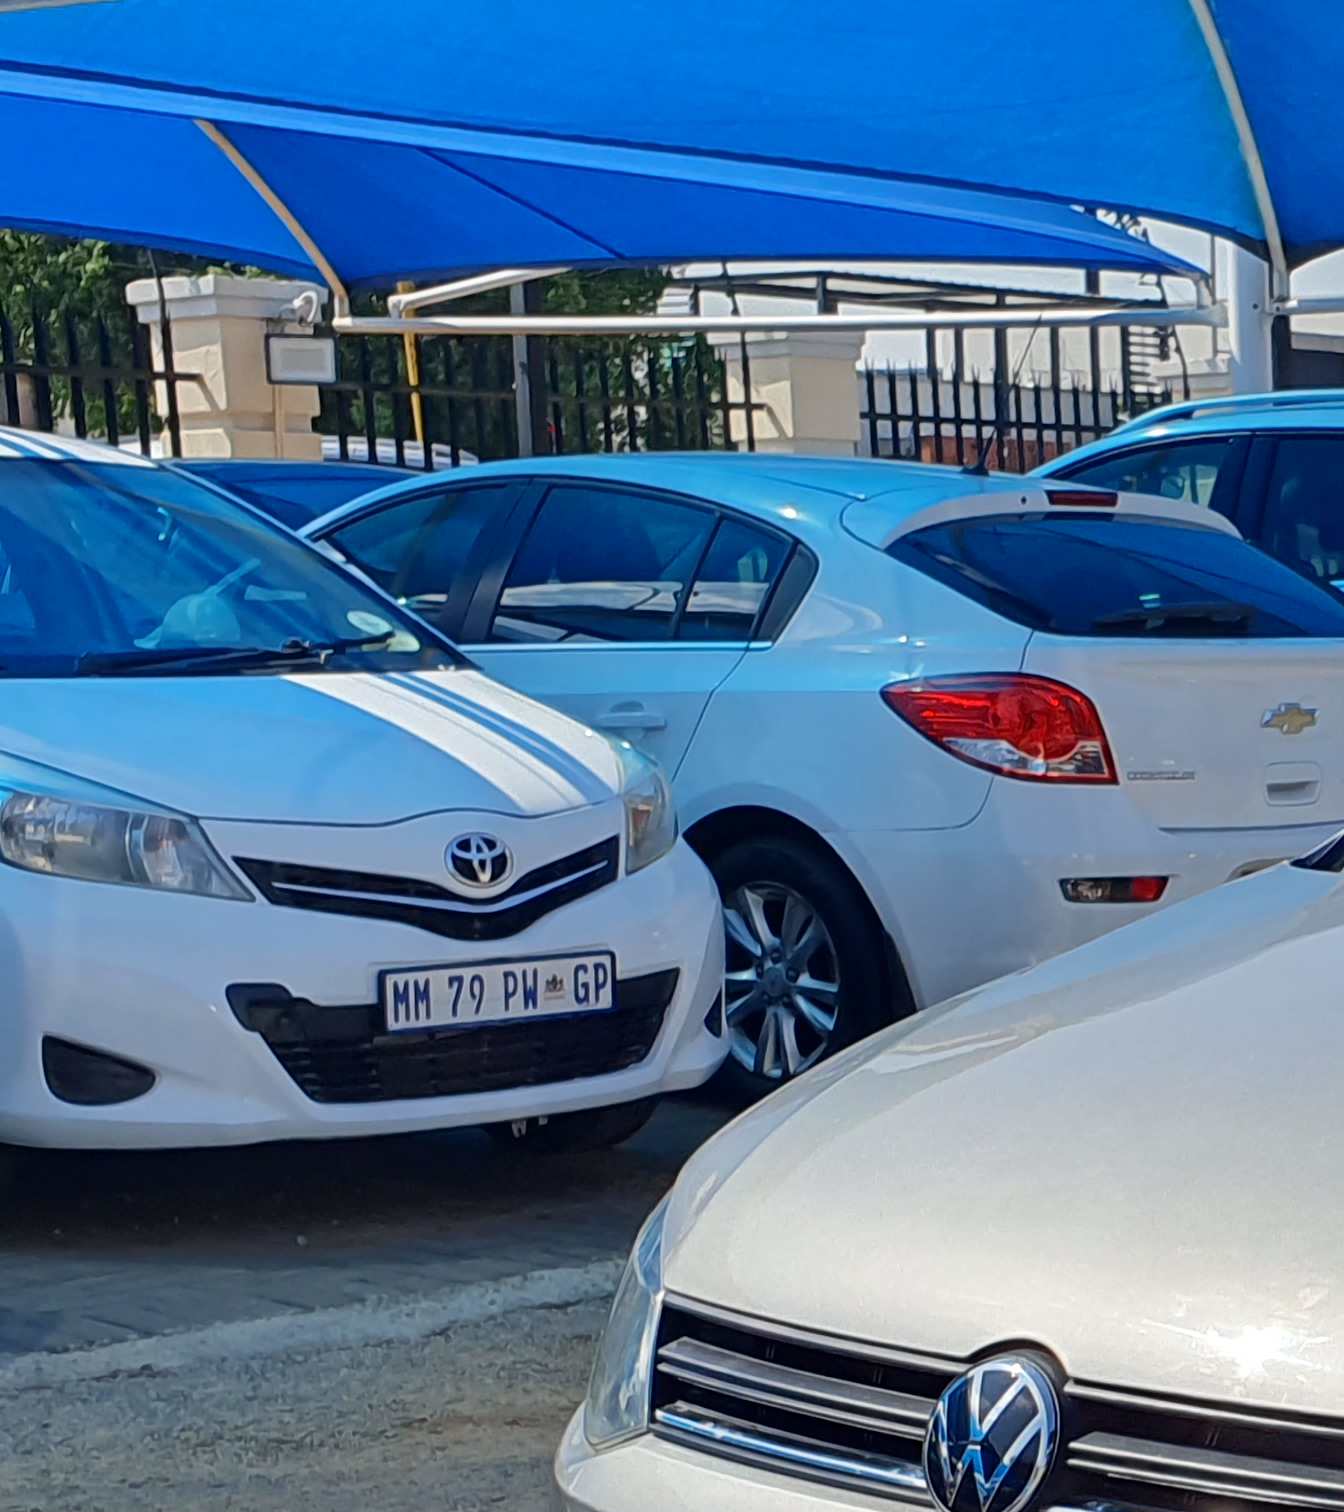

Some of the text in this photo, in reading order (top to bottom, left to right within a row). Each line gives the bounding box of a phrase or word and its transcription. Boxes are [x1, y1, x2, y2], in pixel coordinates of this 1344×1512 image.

[393, 962, 609, 1022] MM 79 PW GP
